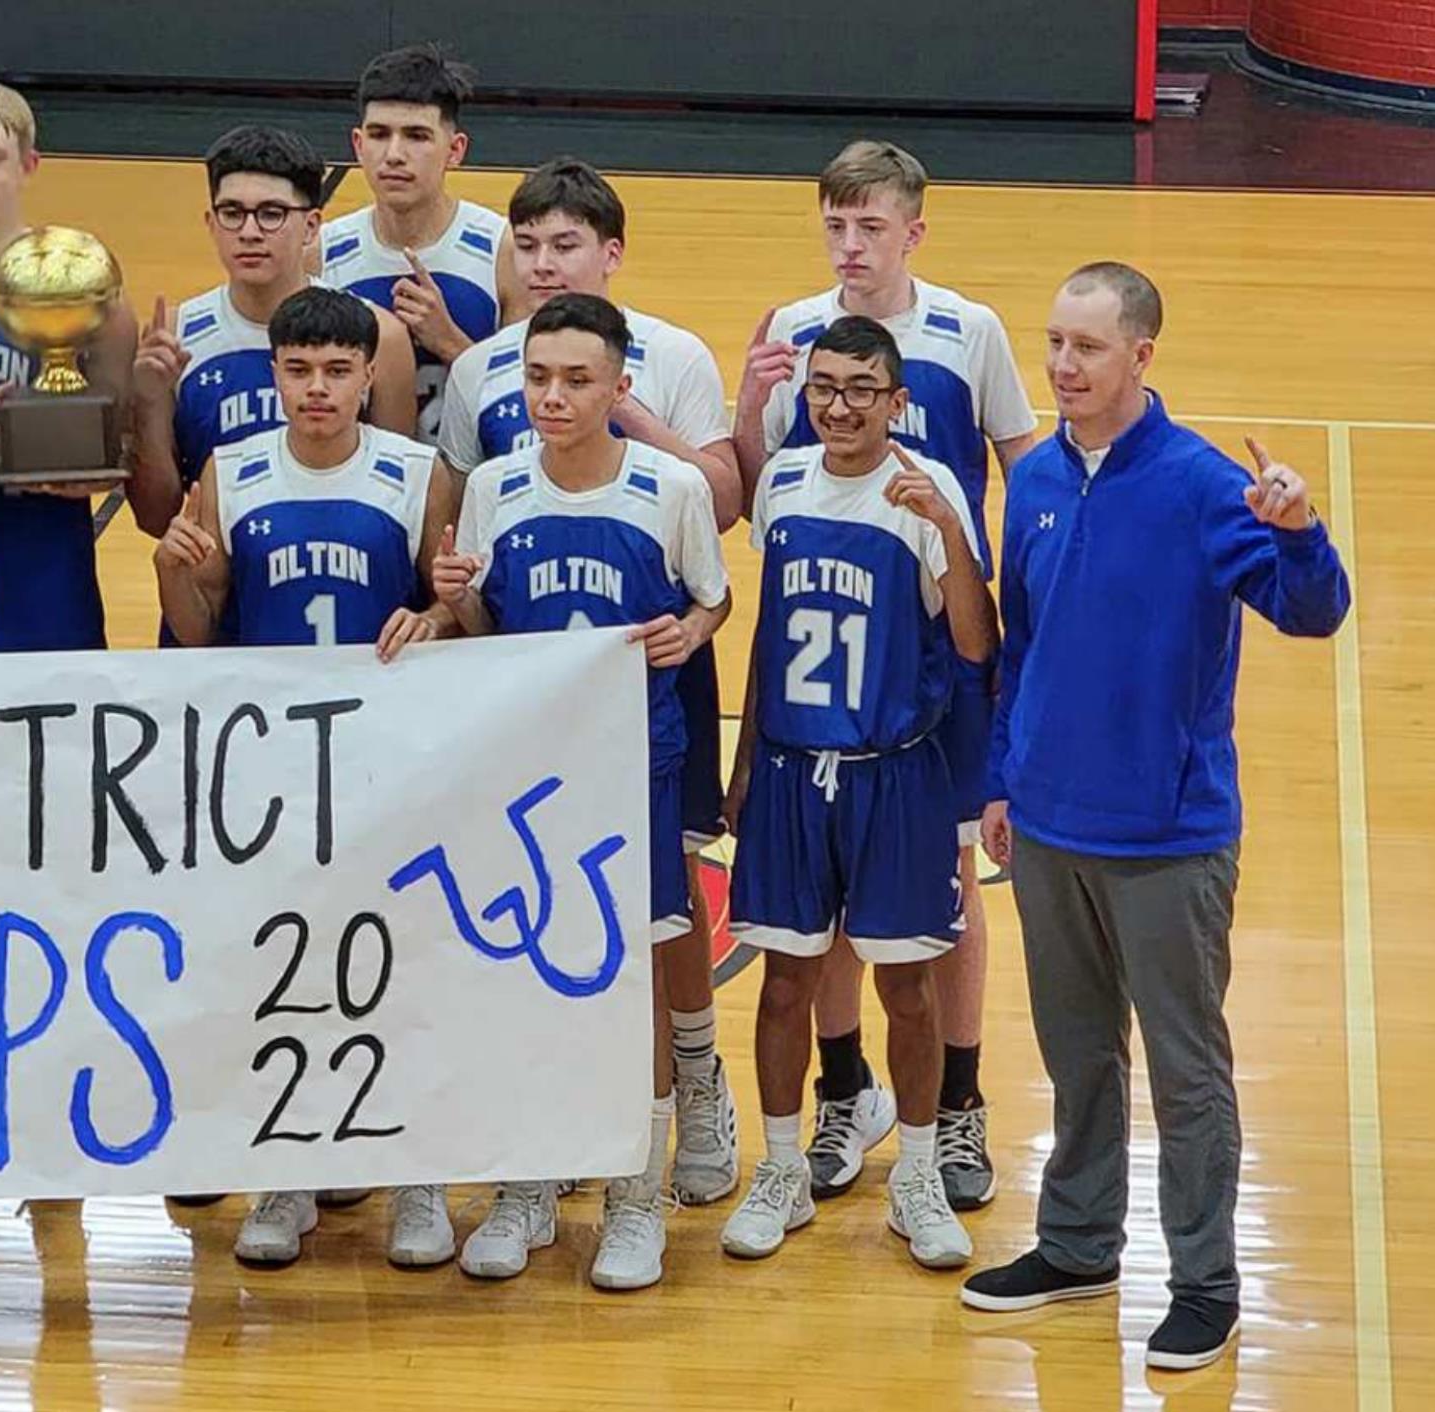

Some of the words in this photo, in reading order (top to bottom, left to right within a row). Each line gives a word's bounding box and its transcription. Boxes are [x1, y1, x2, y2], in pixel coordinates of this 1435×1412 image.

[268, 541, 369, 588] OLTON
[529, 556, 623, 606] OLTON
[783, 558, 873, 608] OLTON
[304, 594, 336, 645] 1
[785, 607, 868, 711] 21
[253, 910, 394, 1020] 20
[251, 1033, 405, 1147] 22
